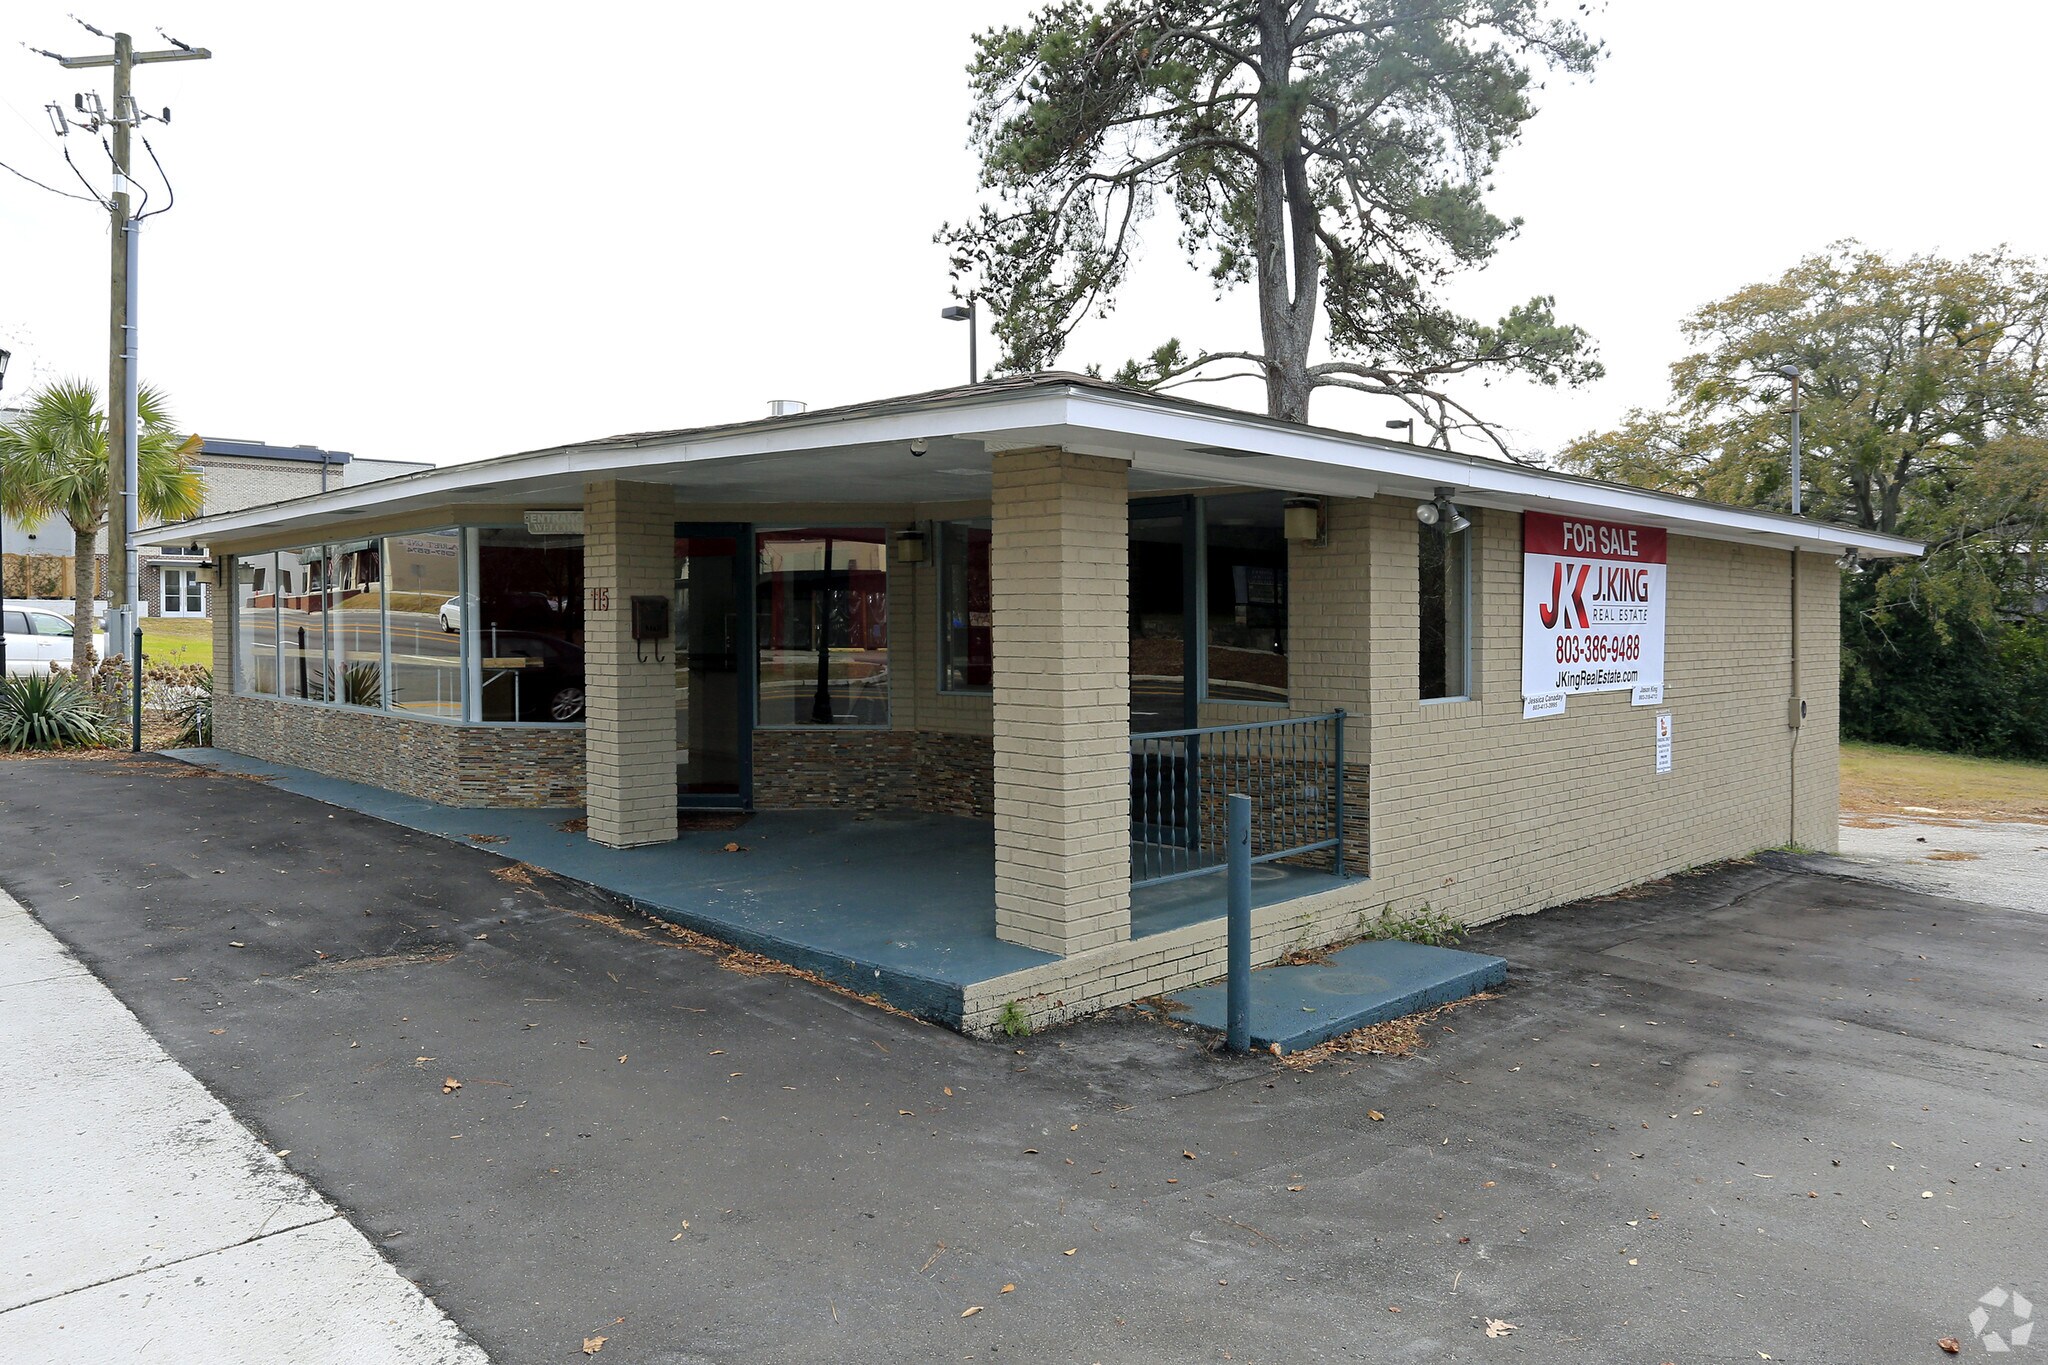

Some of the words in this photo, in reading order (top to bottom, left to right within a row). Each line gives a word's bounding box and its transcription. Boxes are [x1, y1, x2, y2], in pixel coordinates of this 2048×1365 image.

[531, 514, 584, 523] ENTRANC
[533, 524, 584, 534] WELCOM
[1563, 522, 1597, 553] FOR
[1600, 526, 1639, 557] SALE
[1592, 566, 1649, 602] J.KING
[591, 588, 609, 611] 115
[1539, 562, 1592, 630] JK
[1593, 608, 1615, 621] REAL
[1619, 609, 1648, 621] ESTATE
[1556, 634, 1640, 664] 803-386-9488
[1555, 668, 1639, 691] JKingRealEstate.com
[1527, 696, 1545, 705] Jessica
